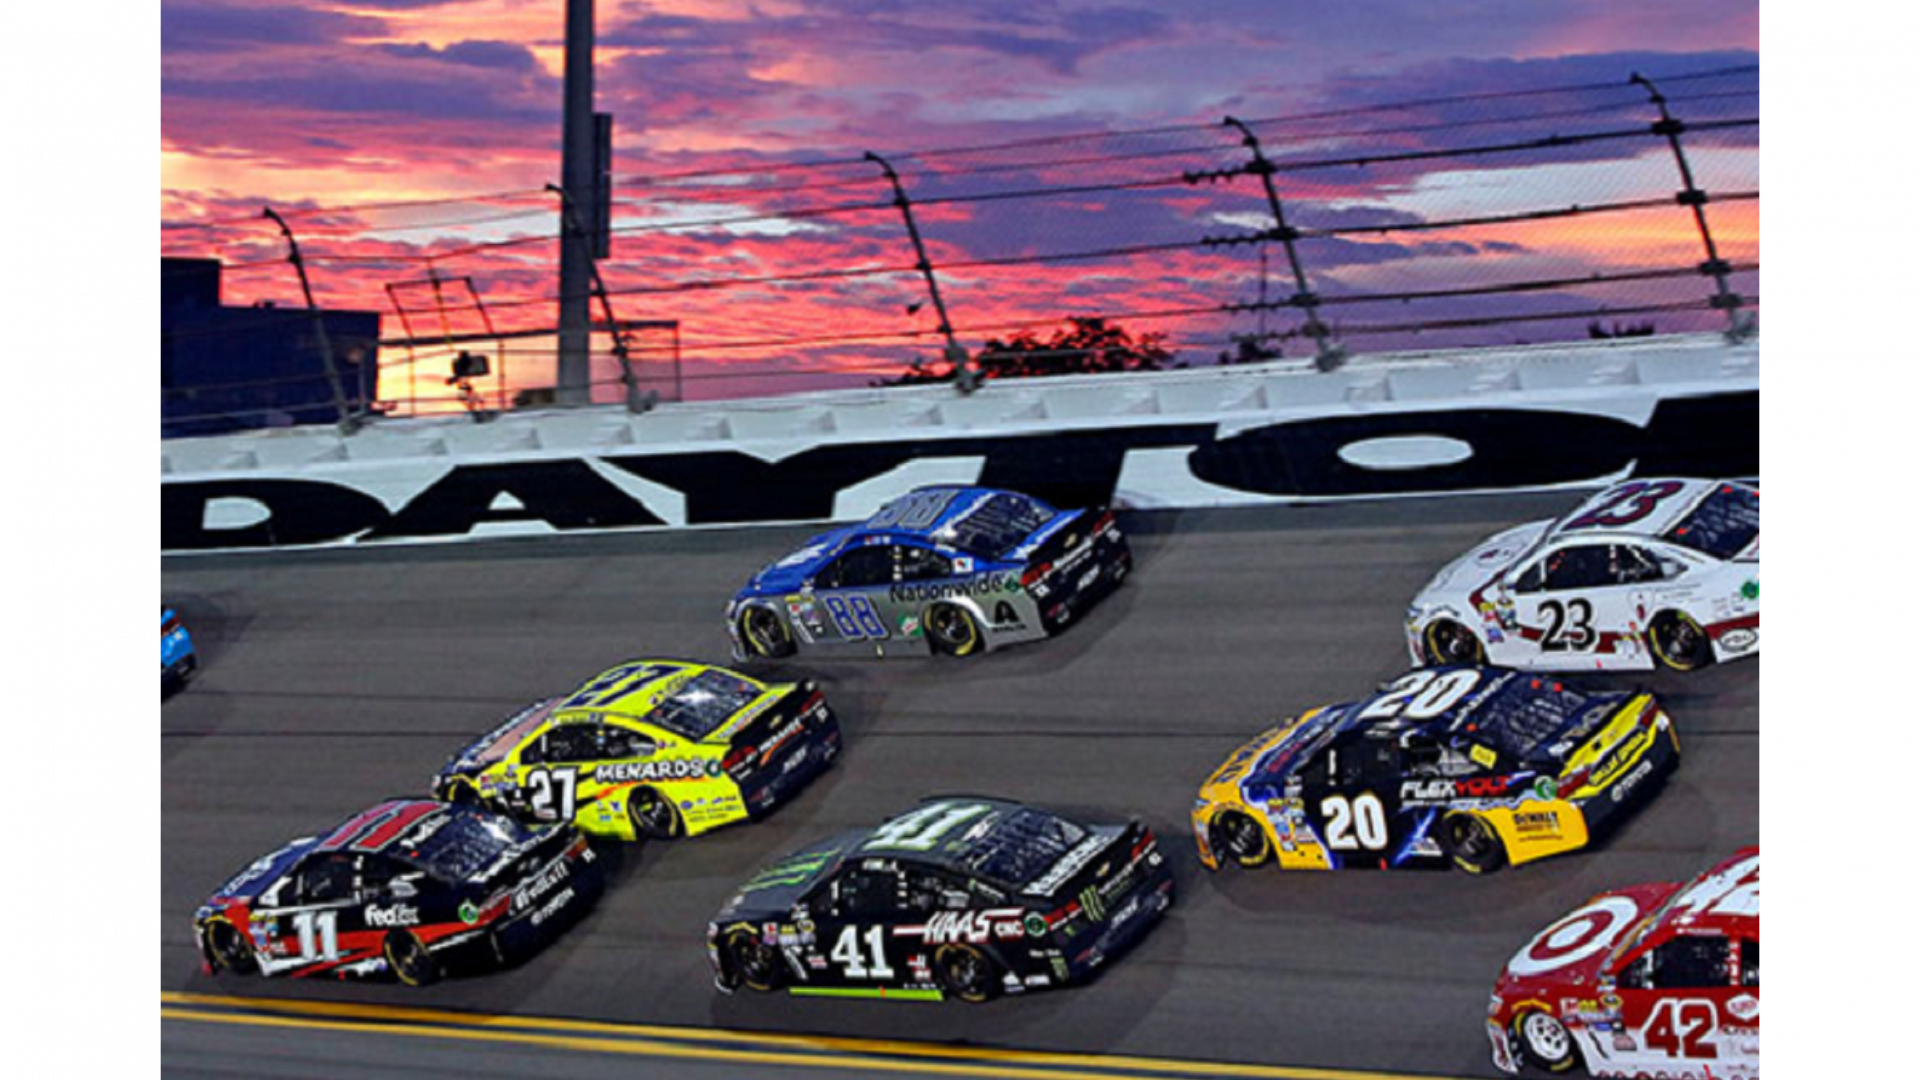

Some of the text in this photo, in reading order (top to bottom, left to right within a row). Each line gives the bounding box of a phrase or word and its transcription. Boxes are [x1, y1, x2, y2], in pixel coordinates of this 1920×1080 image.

[865, 487, 958, 529] 88
[1559, 481, 1686, 532] 23
[889, 562, 1005, 603] Nationwide
[825, 595, 890, 641] 88
[1537, 597, 1596, 652] 23
[1357, 668, 1481, 720] 20
[528, 767, 577, 820] 27
[595, 759, 704, 783] MENARDS
[312, 798, 452, 851] 11
[862, 802, 992, 850] 41
[1321, 793, 1388, 850] 20
[293, 911, 338, 962] 11
[364, 903, 419, 926] FedEx
[921, 907, 1024, 945] HAAS
[831, 924, 894, 978] 41
[1641, 998, 1719, 1060] 42
